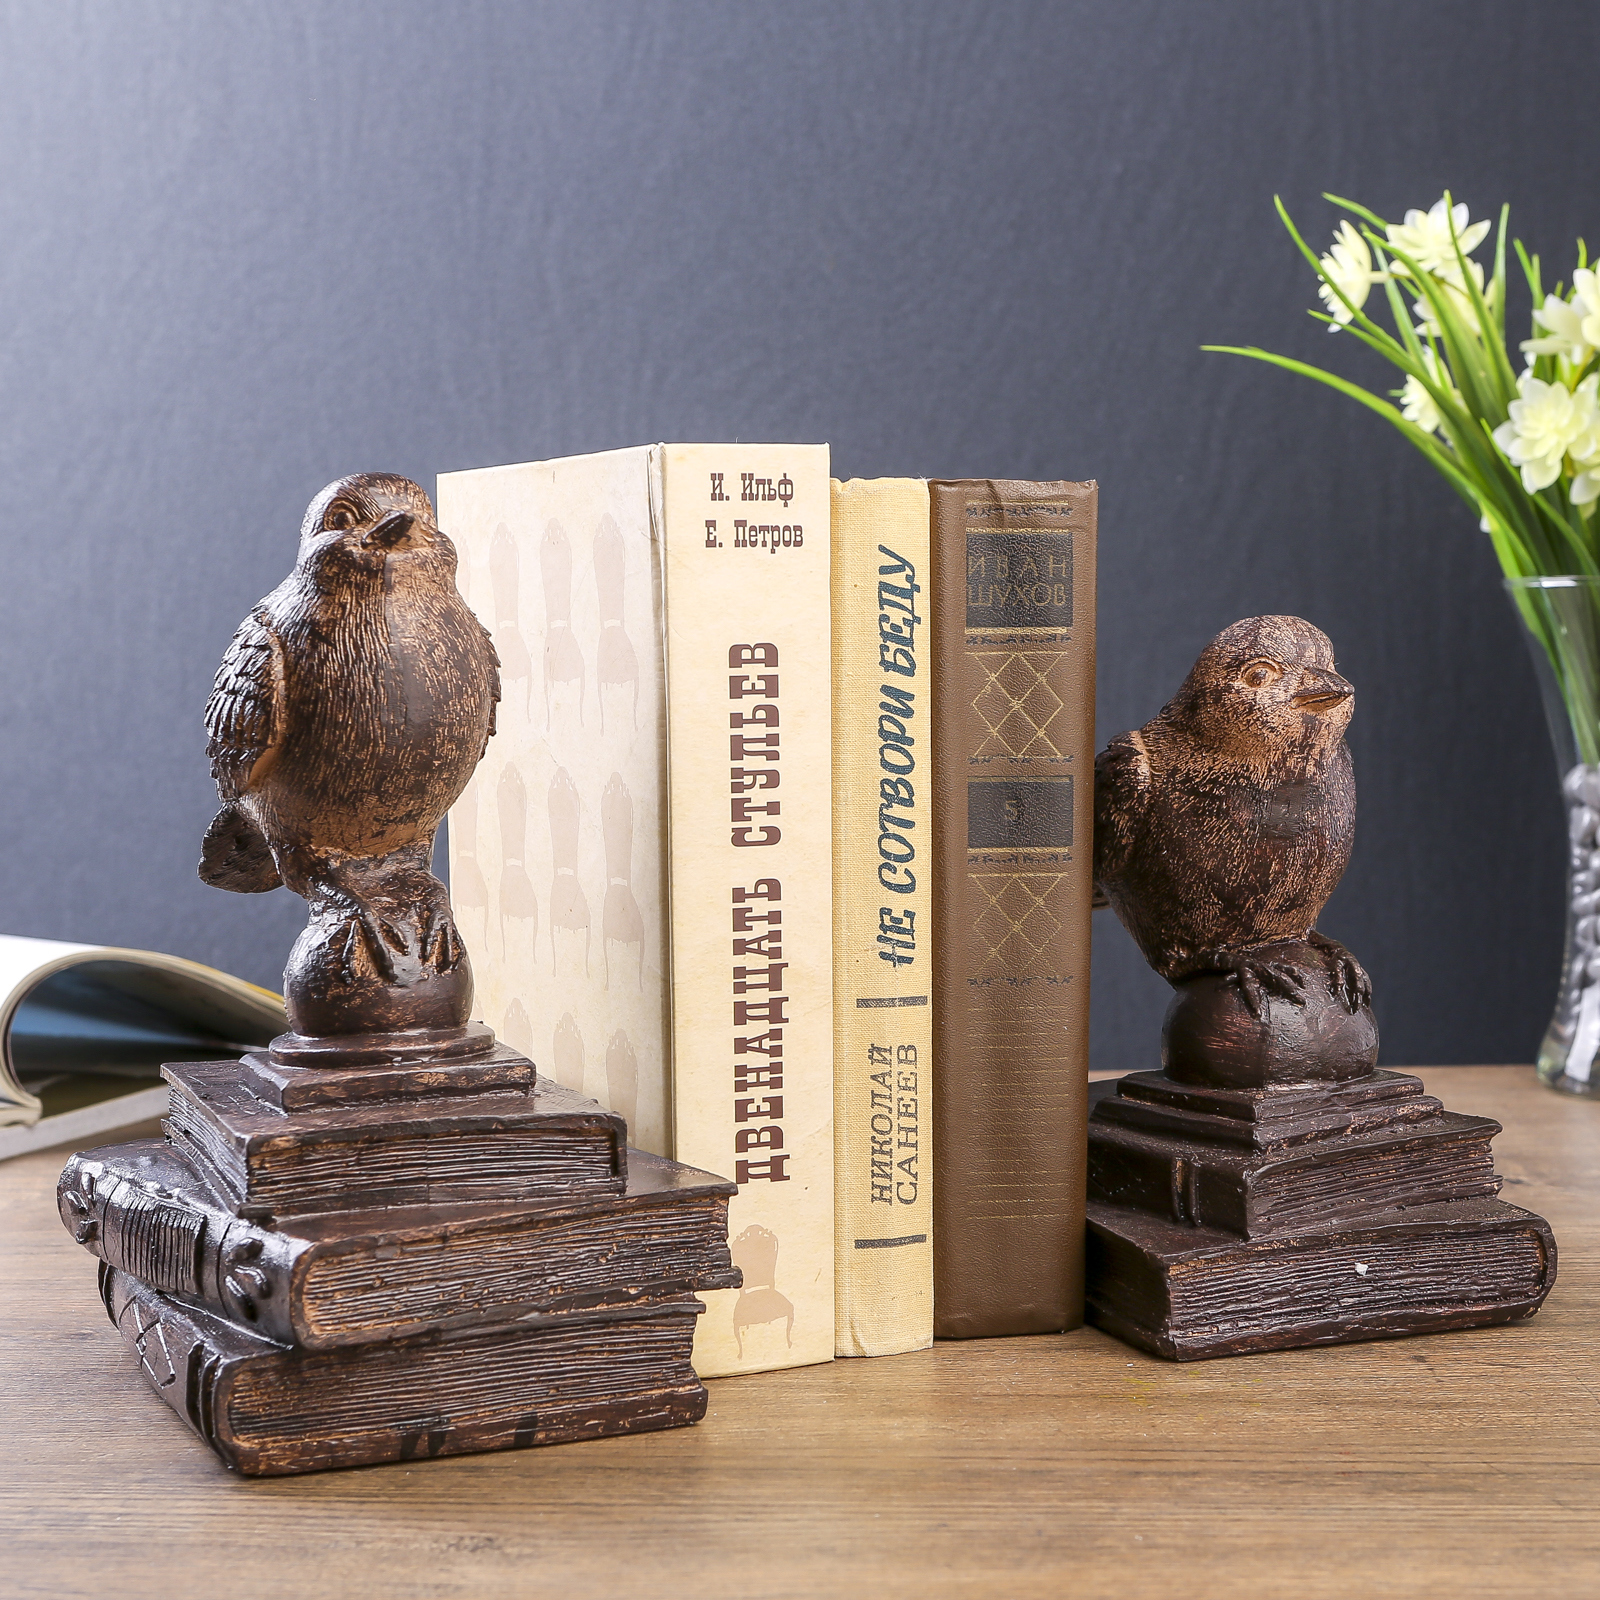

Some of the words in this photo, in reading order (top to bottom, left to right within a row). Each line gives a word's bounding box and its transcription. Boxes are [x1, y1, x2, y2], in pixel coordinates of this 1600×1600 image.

[704, 519, 724, 549] Е.
[733, 519, 804, 554] Петров
[710, 472, 730, 502] И.
[741, 472, 794, 508] Ильф
[878, 544, 921, 677] БЕДУ
[968, 554, 1067, 578] ИВАН
[968, 583, 1067, 607] ШУХОВ
[729, 642, 781, 848] СТУЛЬЕВ
[877, 684, 916, 894] СОТВОРИ
[877, 906, 917, 968] НЕ
[731, 878, 791, 1185] ДВЕНАДЦАТЬ
[868, 1043, 893, 1206] НИКОЛАЙ
[896, 1043, 918, 1206] САНЕЕВ
